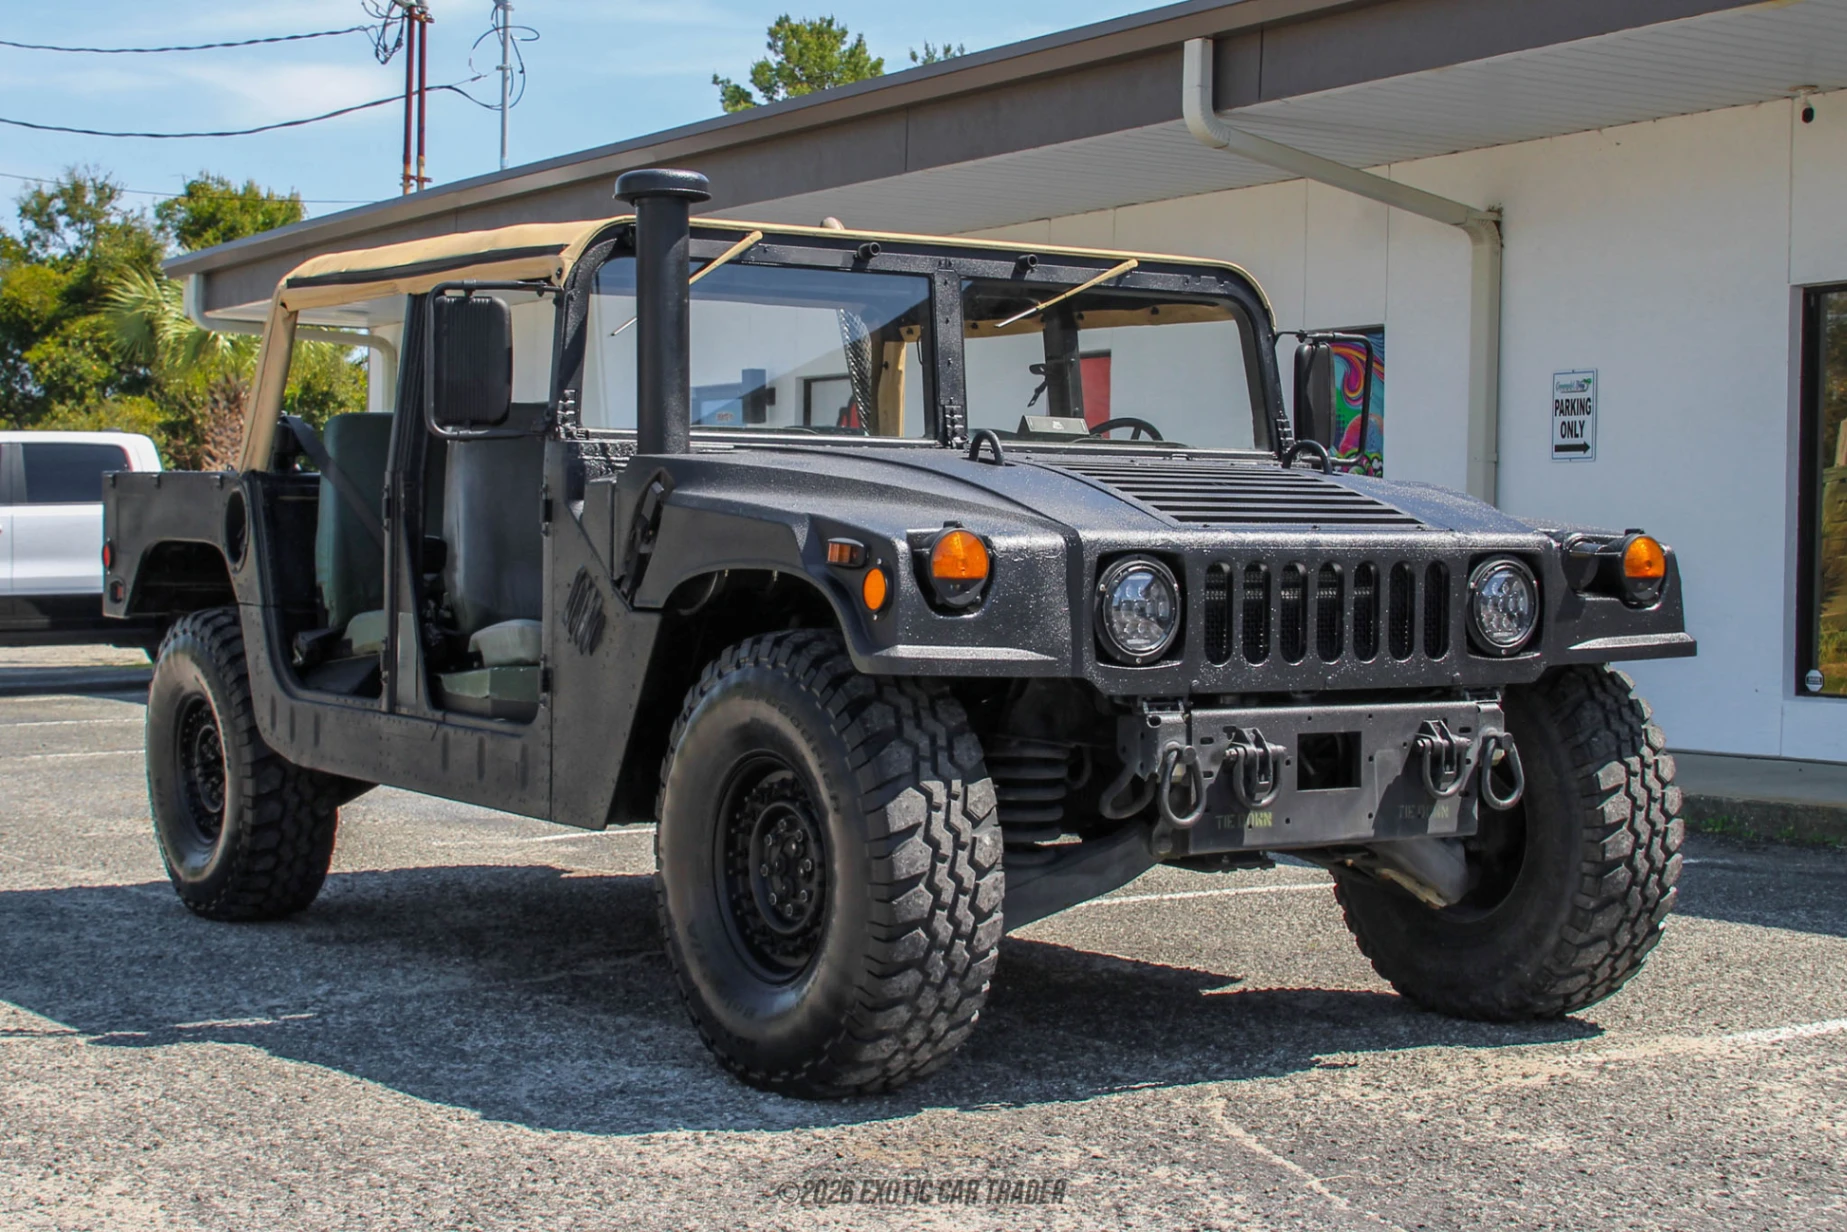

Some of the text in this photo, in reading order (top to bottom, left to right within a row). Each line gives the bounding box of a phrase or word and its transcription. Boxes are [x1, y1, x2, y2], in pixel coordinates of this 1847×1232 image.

[1554, 397, 1592, 417] PARKING
[1560, 420, 1585, 439] ONLY
[1215, 814, 1235, 830] TIE
